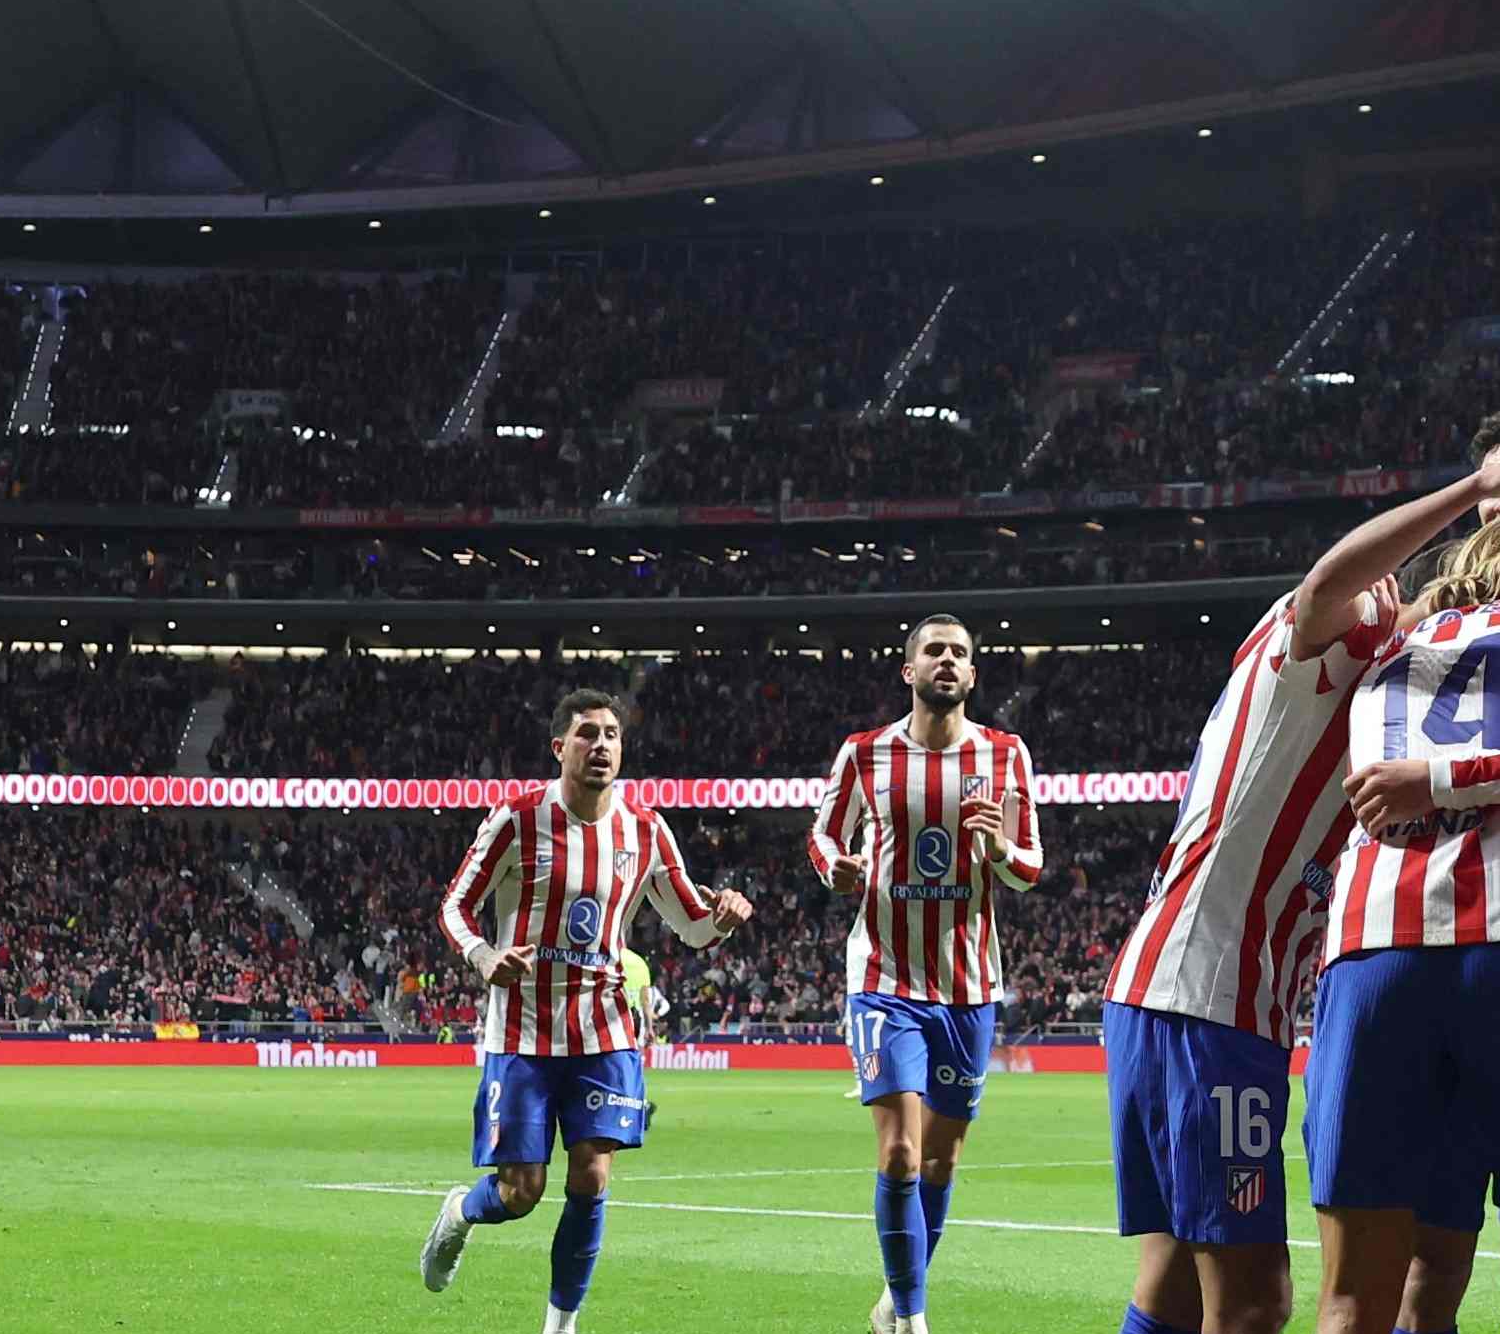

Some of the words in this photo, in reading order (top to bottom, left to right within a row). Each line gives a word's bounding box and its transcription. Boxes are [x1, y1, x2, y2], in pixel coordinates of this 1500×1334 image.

[893, 885, 946, 899] RIYADH
[949, 886, 971, 899] AIR
[540, 947, 588, 964] RIYADH
[855, 1010, 887, 1055] 17
[256, 1040, 377, 1068] Mahou
[649, 1042, 729, 1070] Mahou
[487, 1079, 502, 1122] 2
[1210, 1085, 1272, 1159] 16
